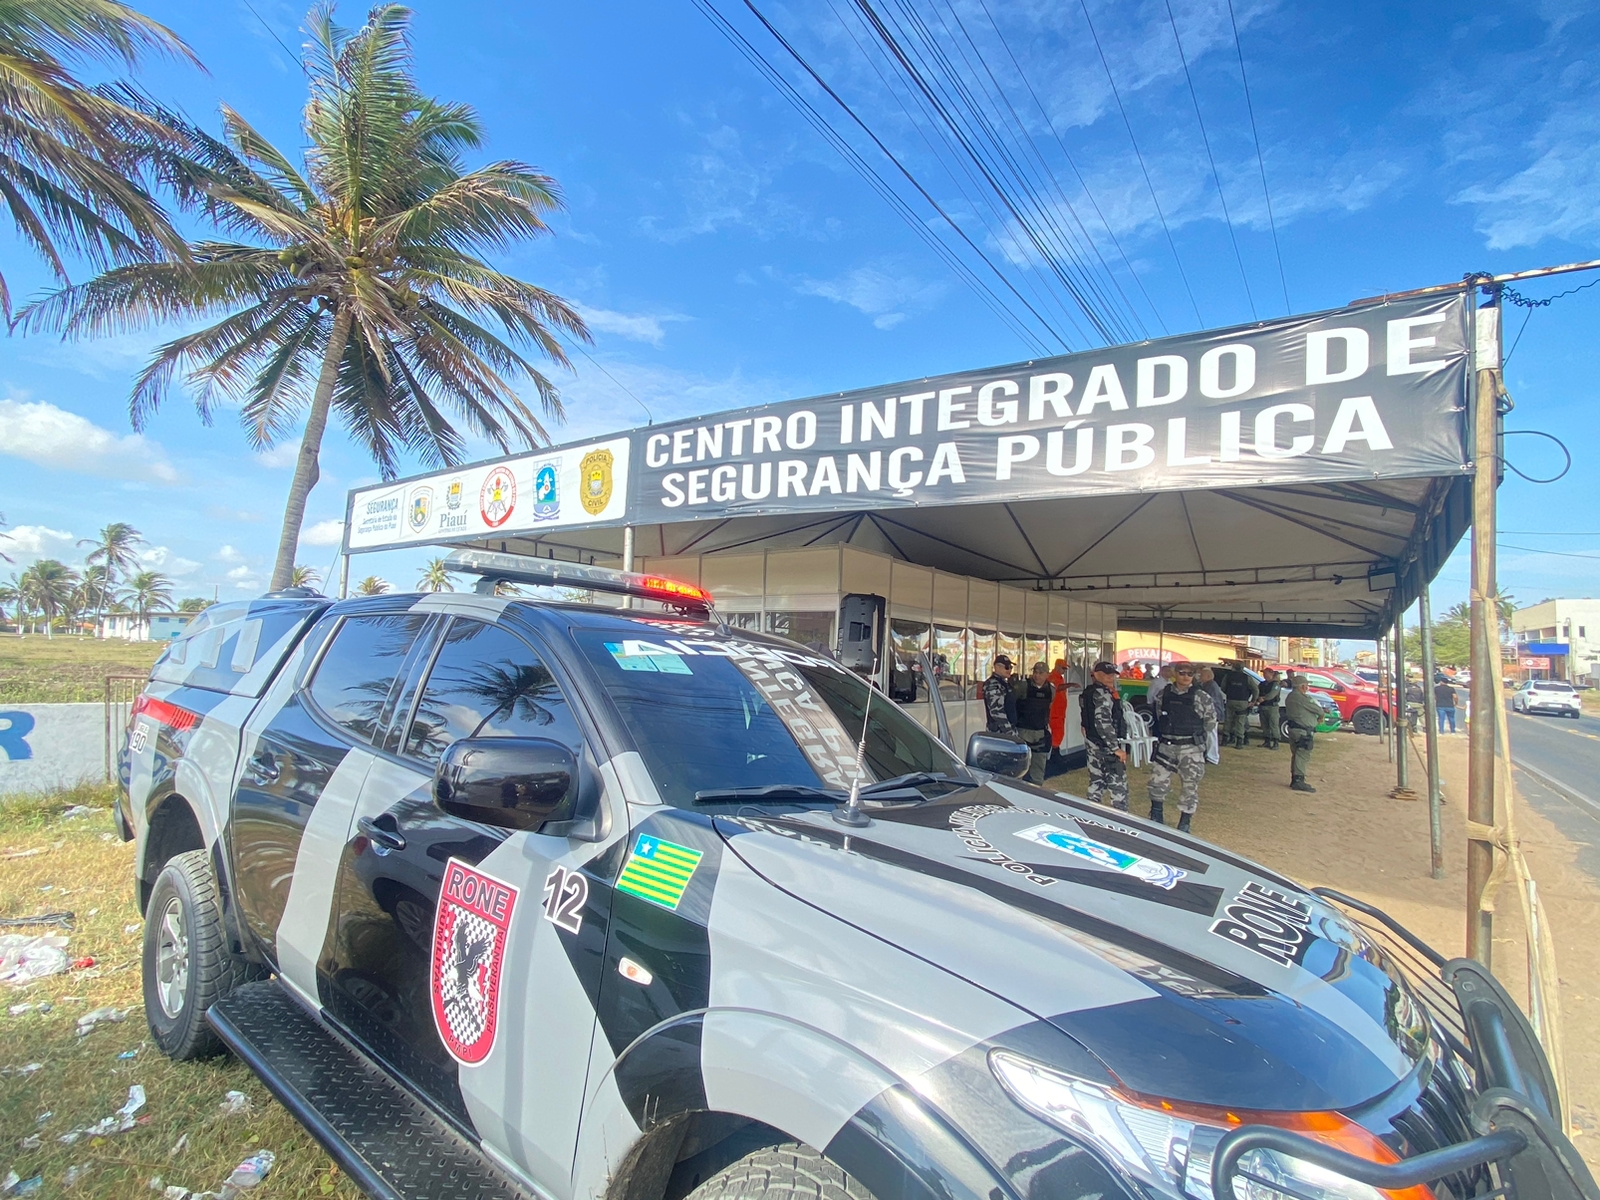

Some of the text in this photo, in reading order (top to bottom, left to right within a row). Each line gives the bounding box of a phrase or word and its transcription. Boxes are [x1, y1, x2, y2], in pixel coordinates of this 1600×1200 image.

[645, 312, 1447, 469] CENTRO INTEGRADO DE
[661, 395, 1394, 508] SEGURANÇA PÚBLICA
[366, 498, 399, 516] SEGURANÇA
[439, 509, 468, 529] Piauí
[587, 498, 604, 507] CIVIL
[131, 731, 147, 752] 190
[446, 867, 510, 921] RONE
[543, 865, 588, 935] 12
[1208, 880, 1313, 970] RONE
[433, 900, 448, 995] HUMILITAS
[486, 930, 505, 1034] PERSEVERANTIA
[448, 1034, 473, 1059] PMPI
